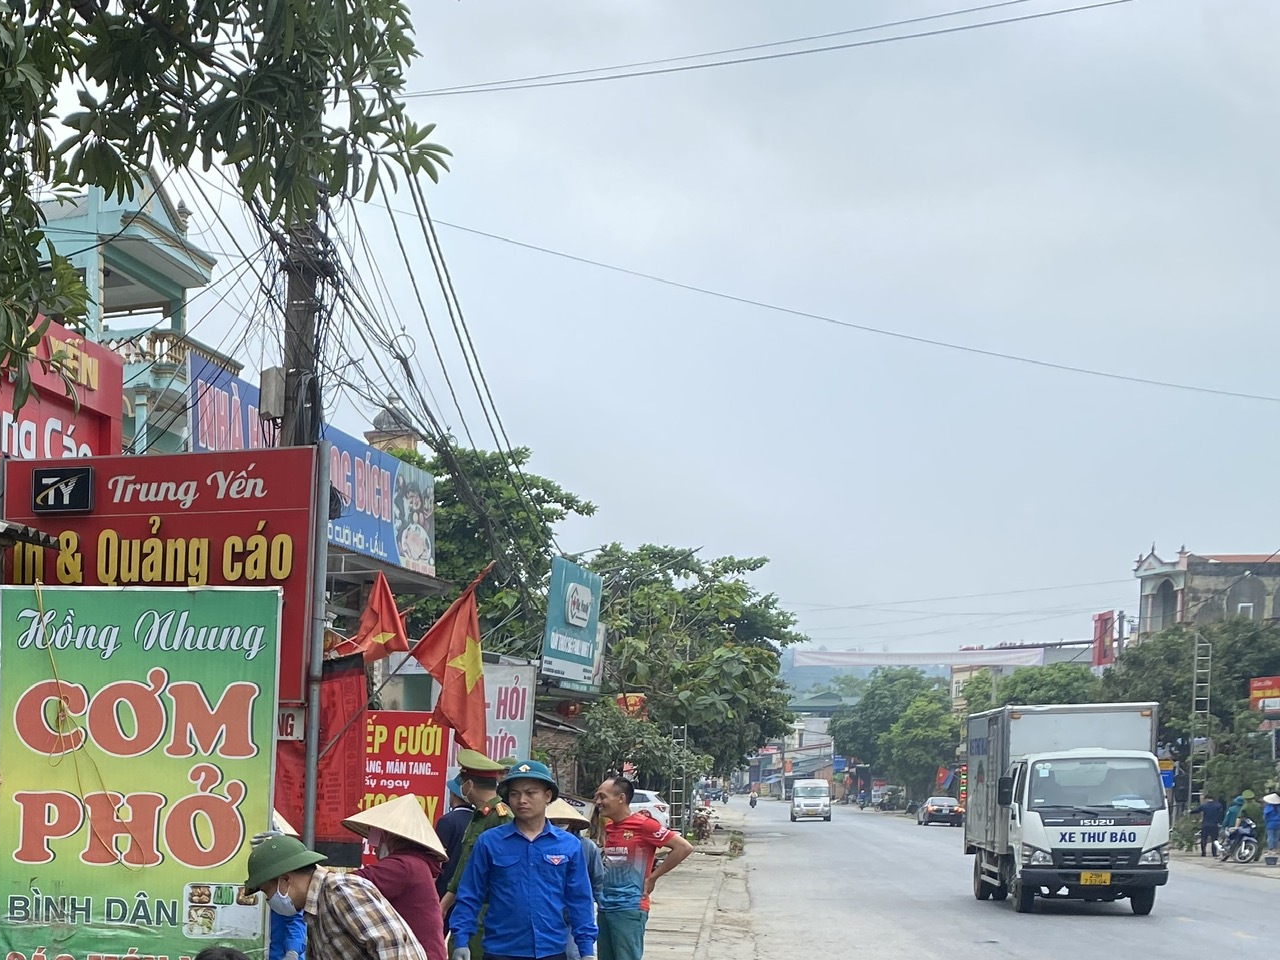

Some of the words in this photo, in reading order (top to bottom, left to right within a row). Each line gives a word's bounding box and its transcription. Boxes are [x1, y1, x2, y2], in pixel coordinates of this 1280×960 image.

[198, 379, 244, 450] NHÀ
[41, 475, 79, 505] TY
[108, 475, 200, 509] Trung
[206, 462, 268, 501] Yến
[355, 451, 392, 523] BÍCH
[56, 530, 83, 584] &
[97, 516, 210, 586] Quảng
[222, 520, 293, 582] cáo
[16, 608, 122, 655] Hồng
[135, 610, 267, 661] Nhung
[13, 667, 262, 758] CƠM
[495, 674, 528, 721] HỎI
[366, 714, 388, 754] ẾP
[394, 718, 443, 756] CƯỚI
[380, 778, 410, 789] ngay
[12, 762, 248, 869] PHỞ
[1059, 832, 1076, 843] XE
[1081, 831, 1108, 843] THƯ
[1110, 830, 1137, 843] BÁO
[8, 887, 92, 924] BÌNH
[105, 891, 178, 927] DÂN
